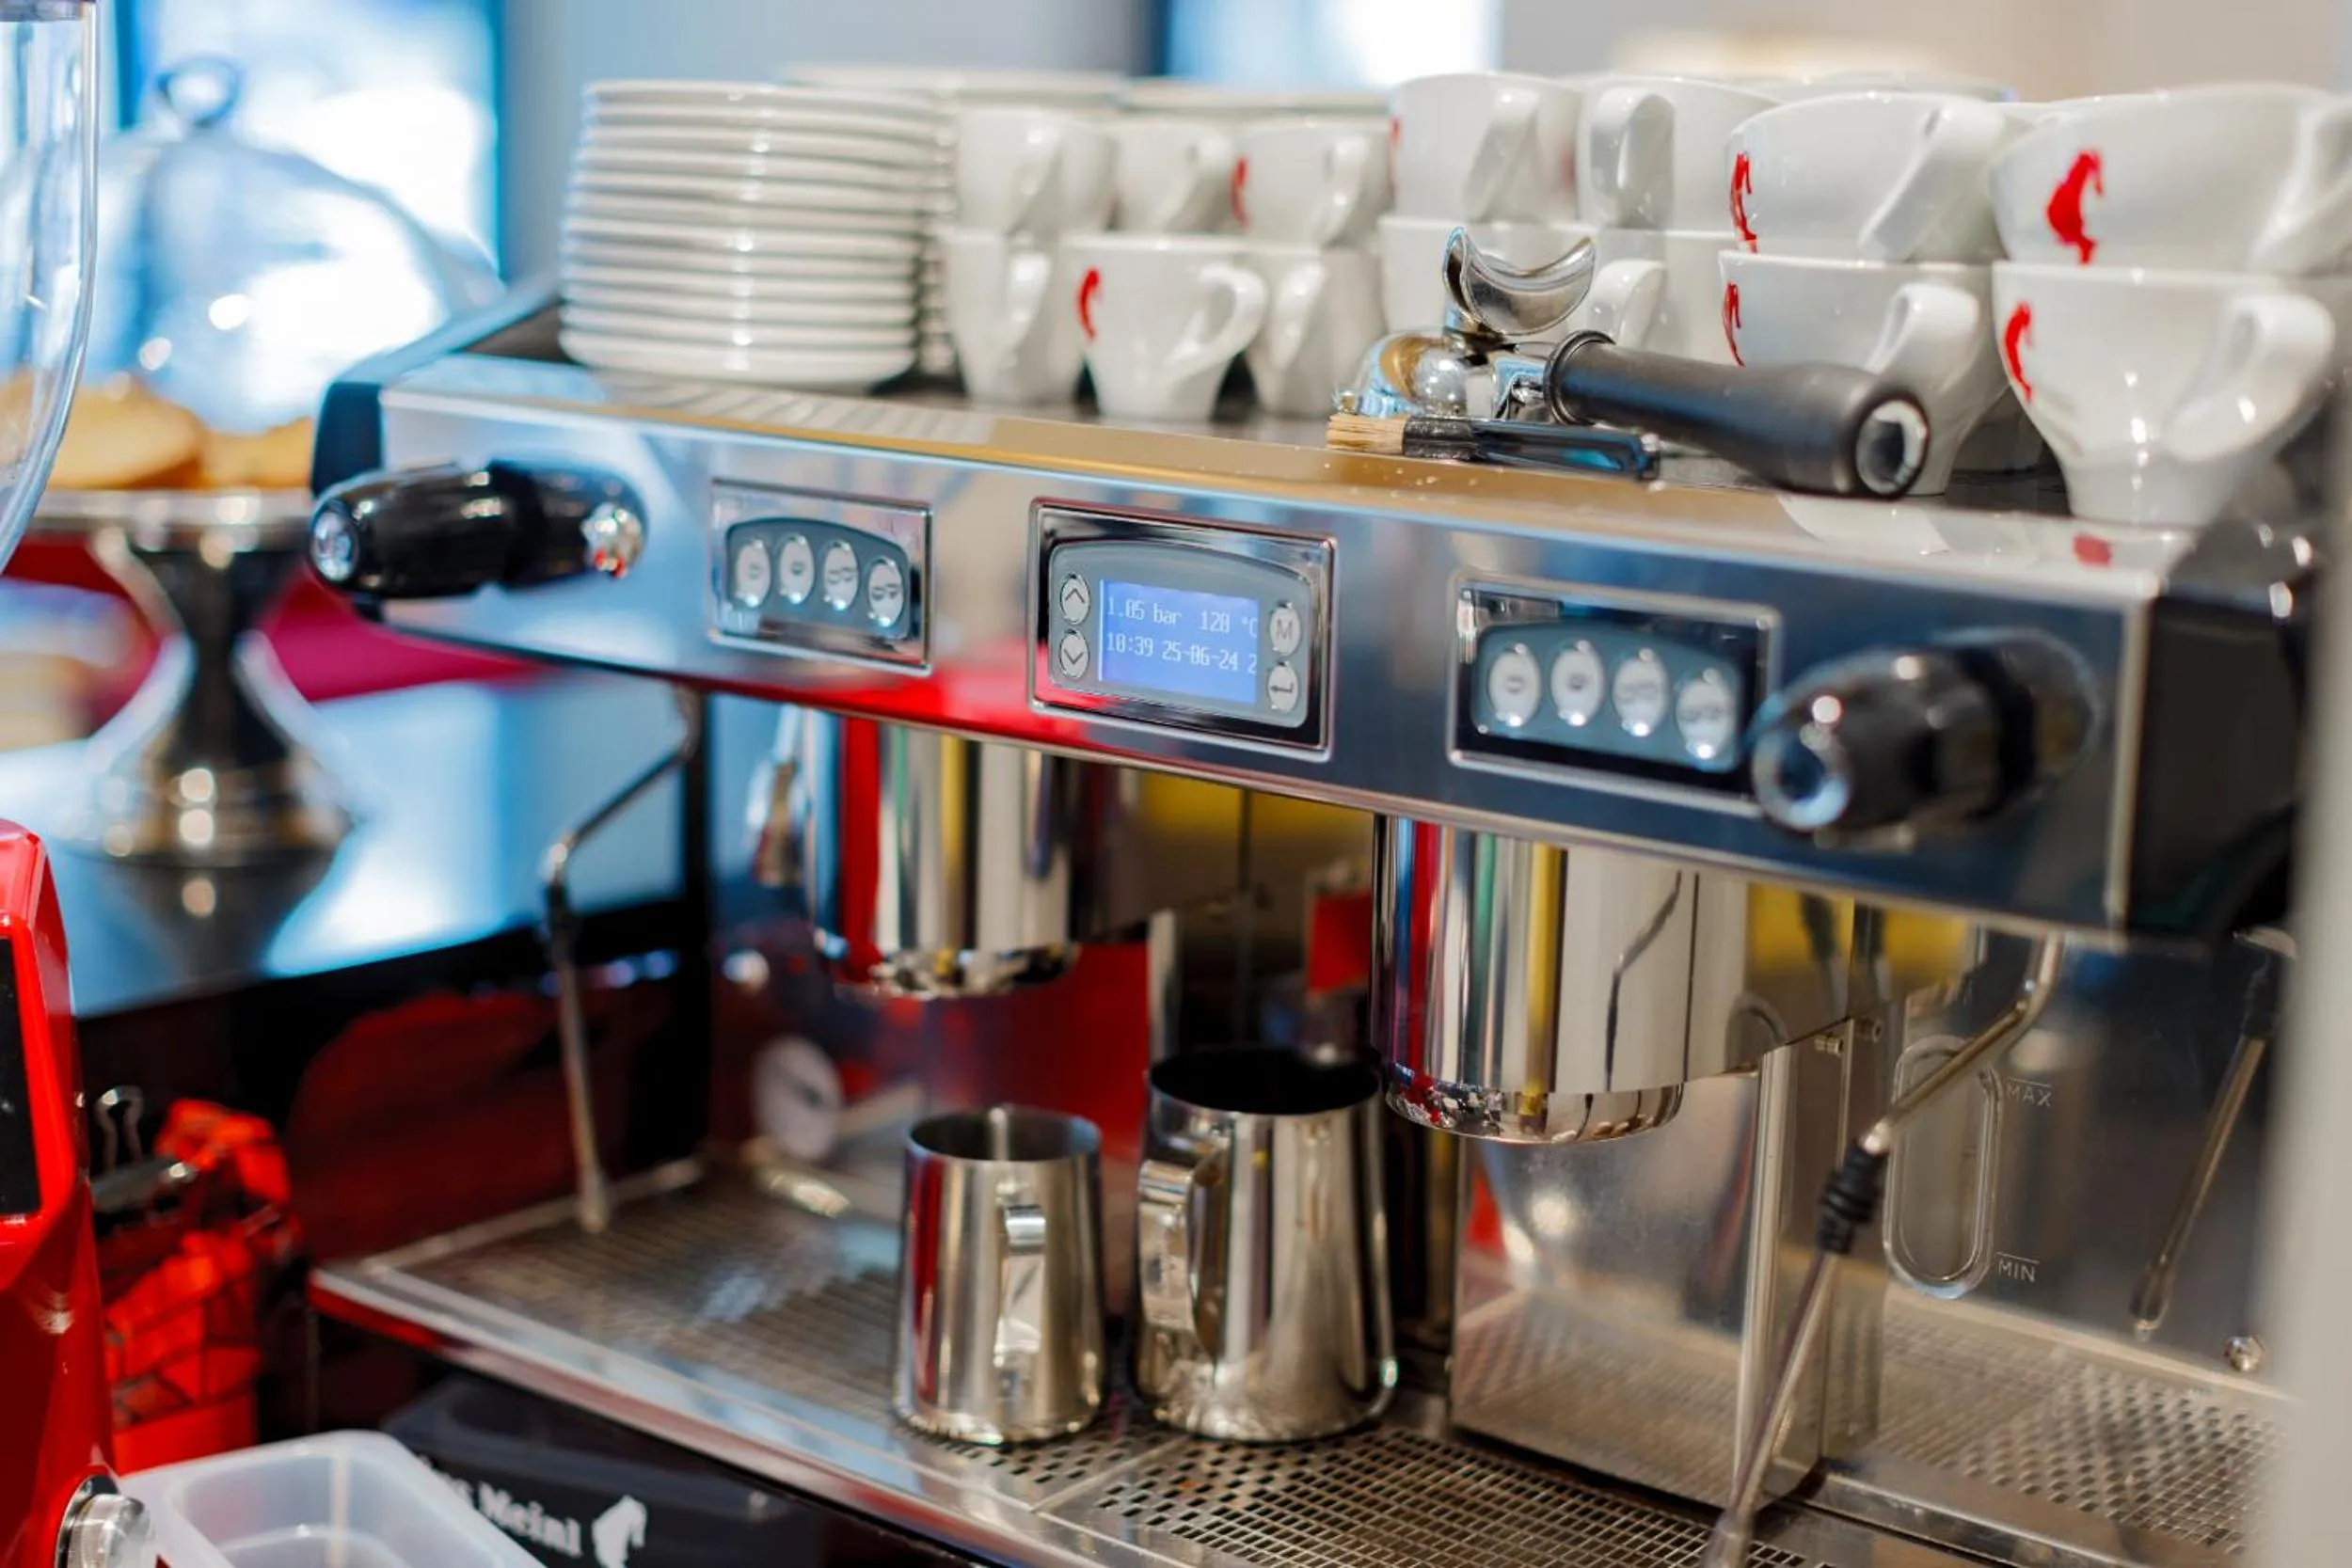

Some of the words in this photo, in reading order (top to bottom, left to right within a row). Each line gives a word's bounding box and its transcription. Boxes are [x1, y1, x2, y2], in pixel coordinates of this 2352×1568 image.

[1153, 602, 1183, 626] bar
[1276, 617, 1294, 641] M
[1106, 631, 1154, 657] 10:39
[1162, 640, 1239, 672] 25-06-24
[2006, 1083, 2052, 1107] MAX
[1998, 1259, 2037, 1283] MIN
[478, 1480, 583, 1559] Meinl
